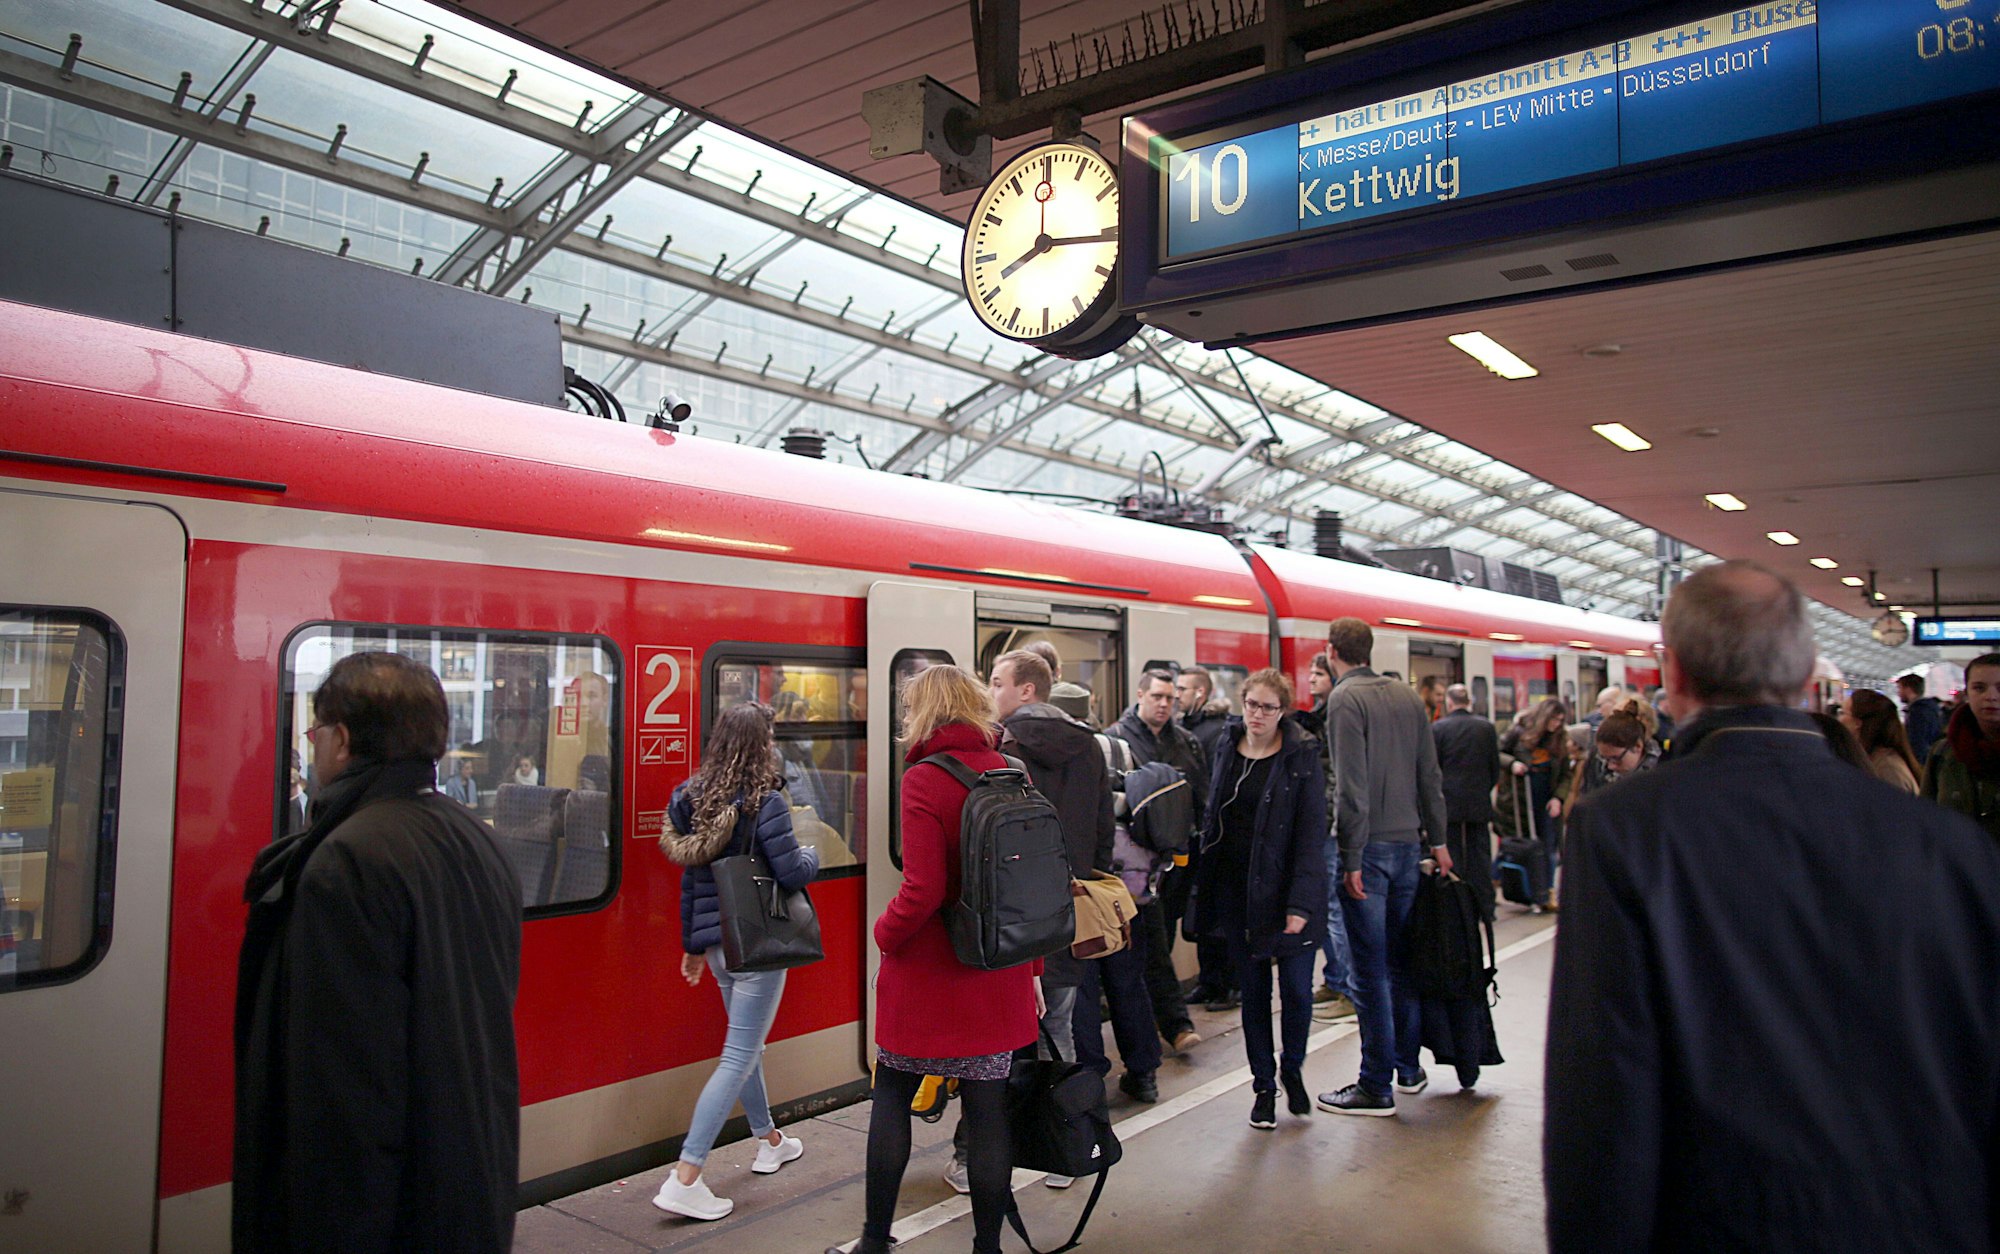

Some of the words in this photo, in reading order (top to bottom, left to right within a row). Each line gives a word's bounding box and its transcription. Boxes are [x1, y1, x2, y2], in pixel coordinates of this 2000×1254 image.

[1299, 151, 1311, 172] K
[1317, 120, 1457, 168] Messe/Deutz
[1482, 101, 1522, 130] LEV
[1530, 88, 1594, 119] Mitte
[1623, 41, 1771, 98] Düsseldorf
[1335, 108, 1387, 133] hält
[1394, 96, 1422, 118] im
[1431, 57, 1569, 110] Abschnitt
[1578, 40, 1632, 73] A-B
[1175, 143, 1248, 223] 10
[1299, 153, 1460, 220] Kettwig
[643, 653, 681, 724] 2
